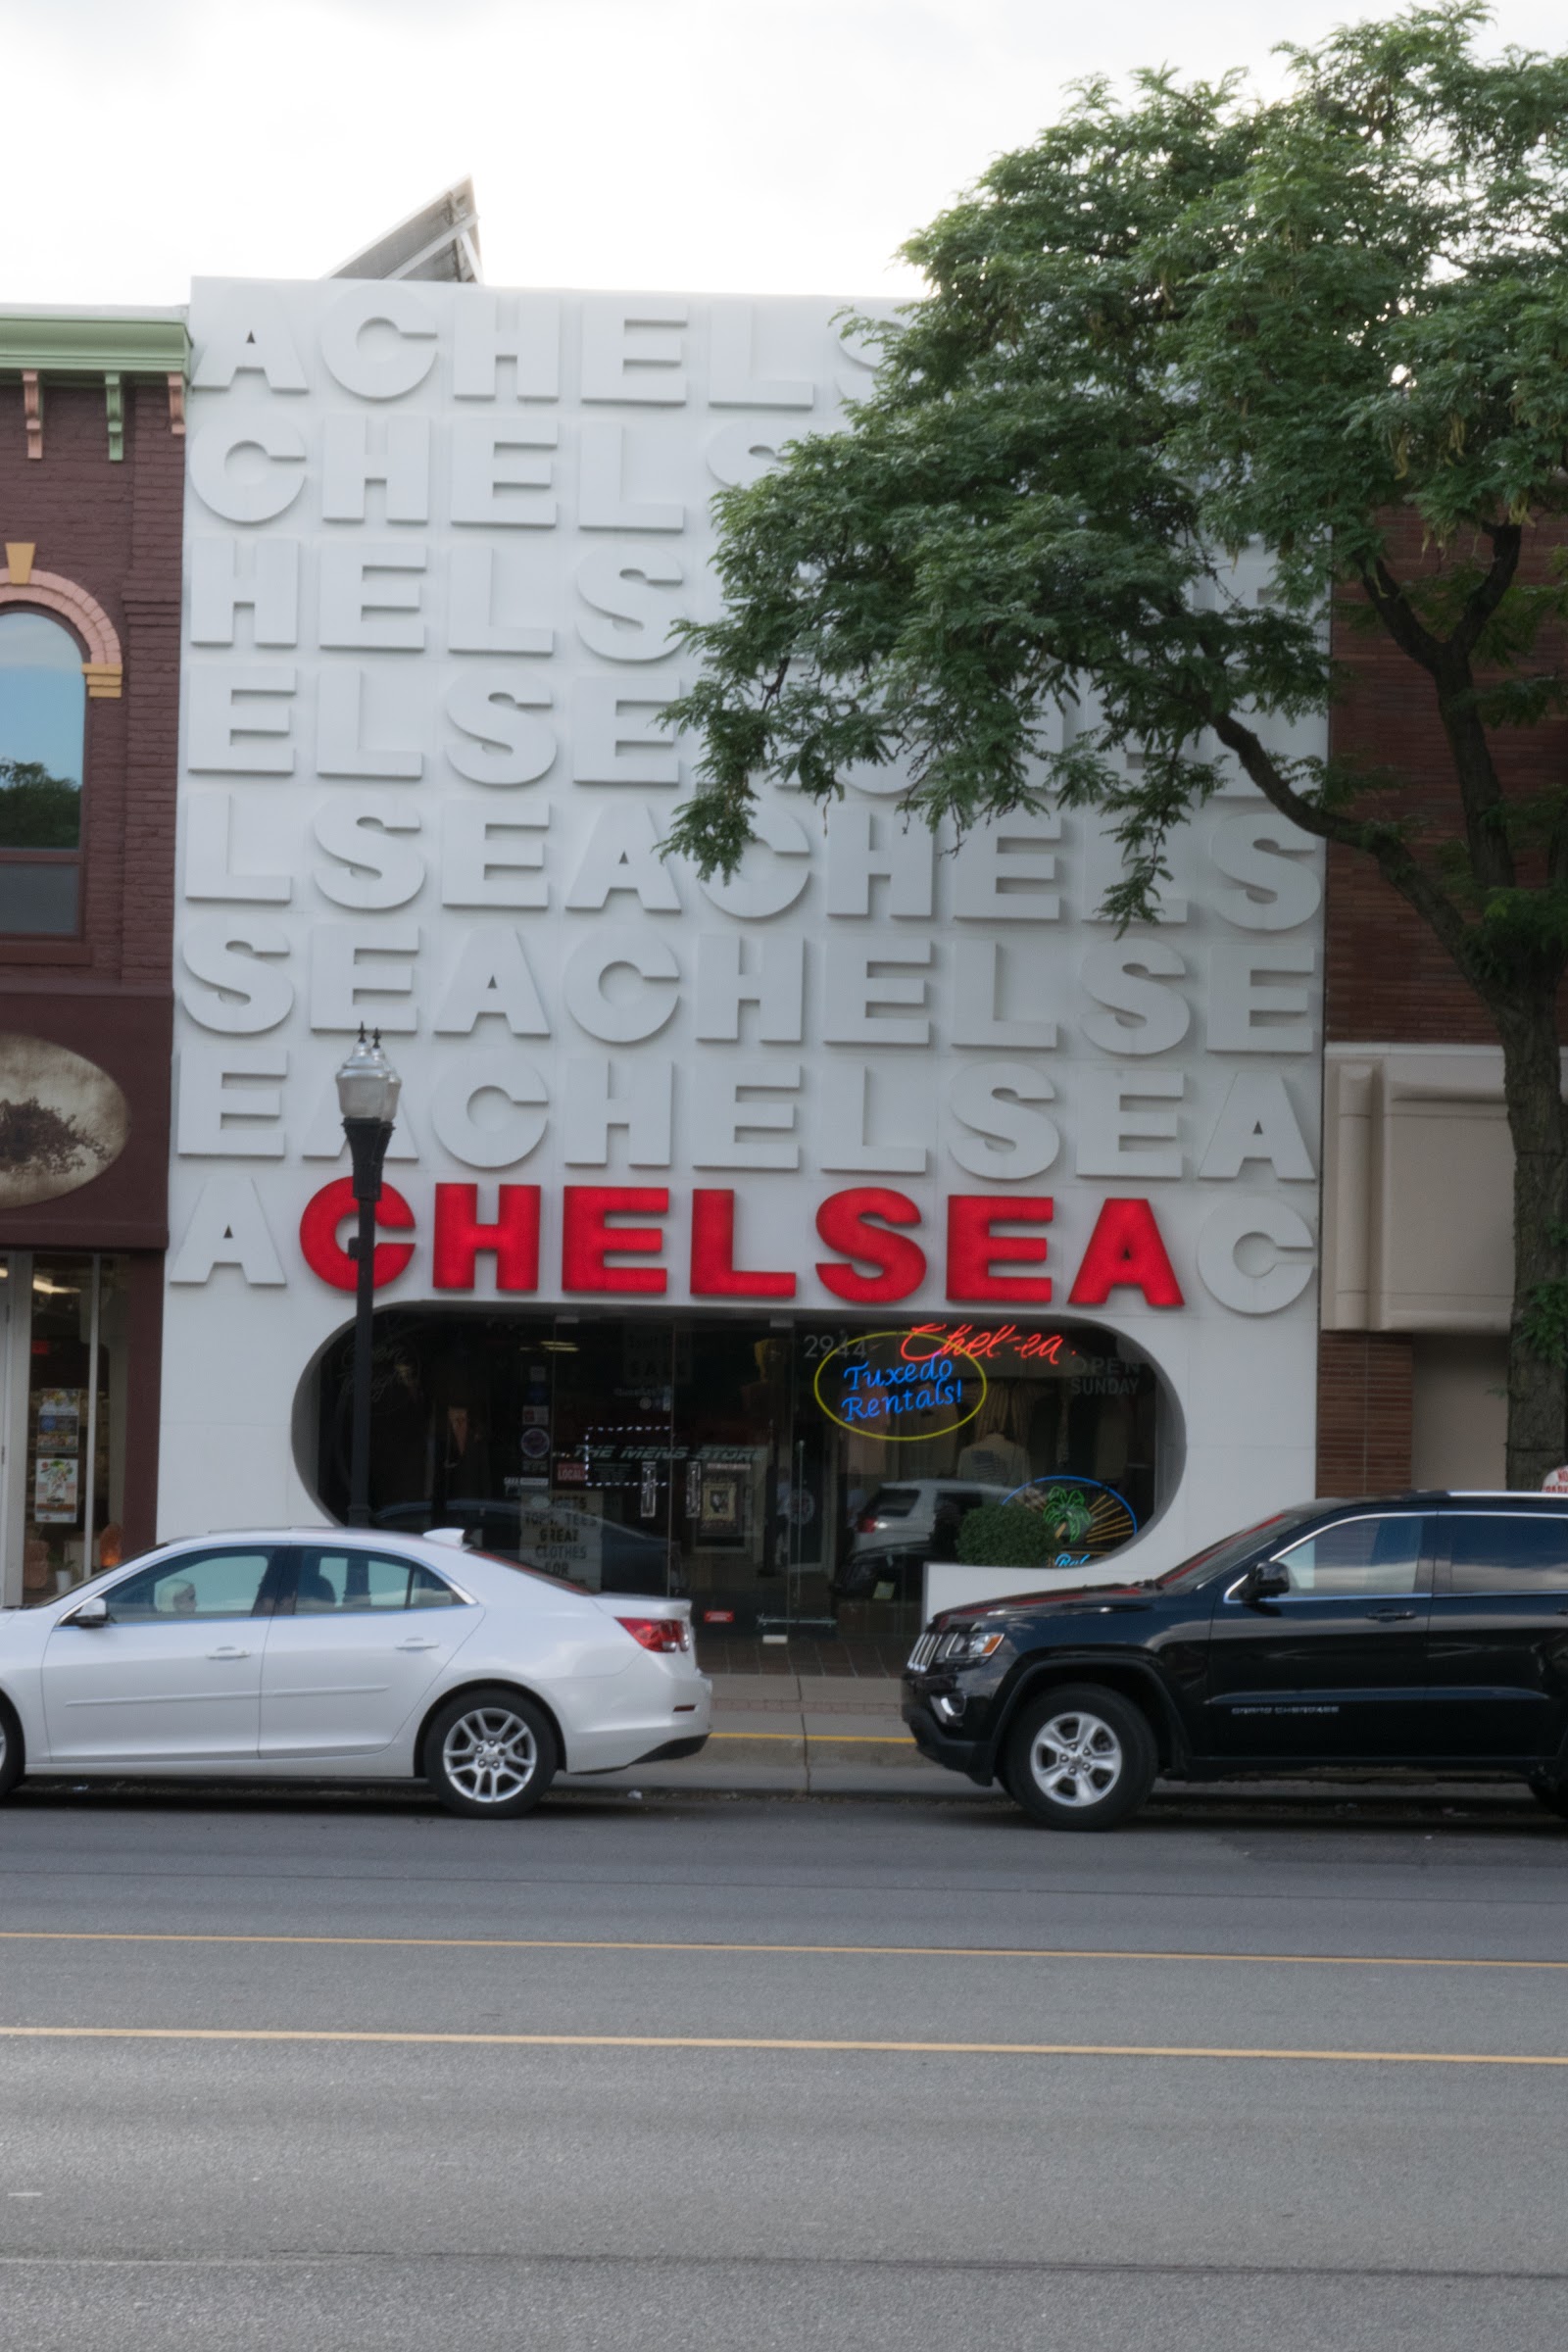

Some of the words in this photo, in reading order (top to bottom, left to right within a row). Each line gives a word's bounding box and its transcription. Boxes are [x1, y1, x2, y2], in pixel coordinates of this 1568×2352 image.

[804, 1334, 866, 1359] 2944
[843, 1351, 954, 1392] Tuxedo
[1071, 1377, 1140, 1396] SUNDAY
[841, 1377, 963, 1423] Rentals!
[573, 1445, 616, 1458] THE
[540, 1528, 579, 1543] GREAT
[535, 1544, 588, 1559] CLOTHES
